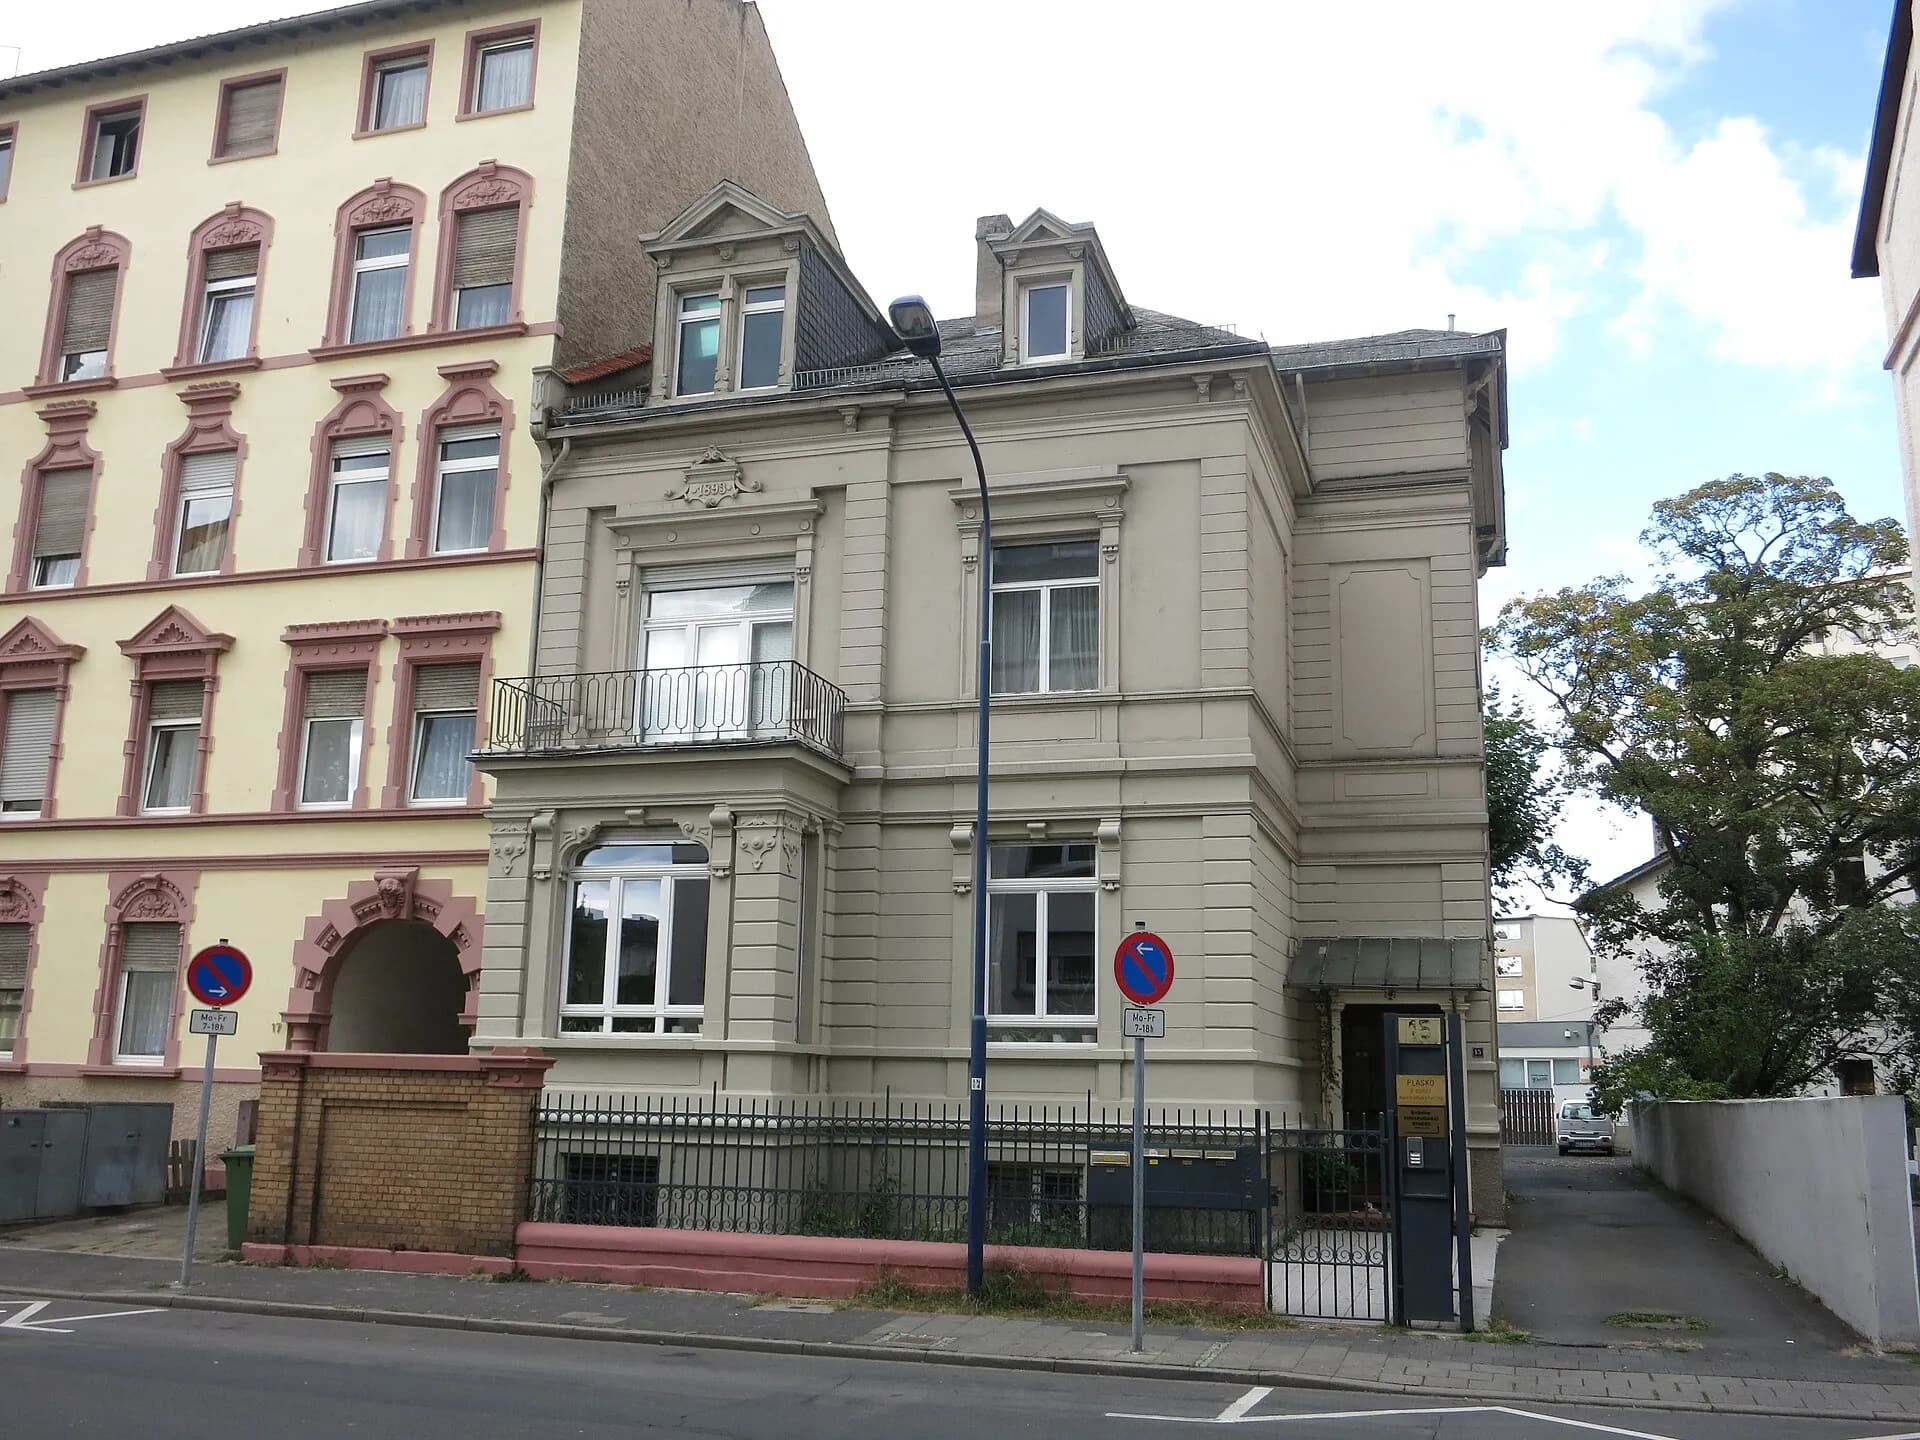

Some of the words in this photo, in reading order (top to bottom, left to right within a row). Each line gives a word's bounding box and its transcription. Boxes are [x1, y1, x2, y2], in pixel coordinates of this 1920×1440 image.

[201, 1013, 227, 1022] Mo-Fr
[1132, 1013, 1156, 1022] Mo-Fr
[202, 1022, 225, 1031] 7-18h
[1134, 1024, 1154, 1033] 7-18h
